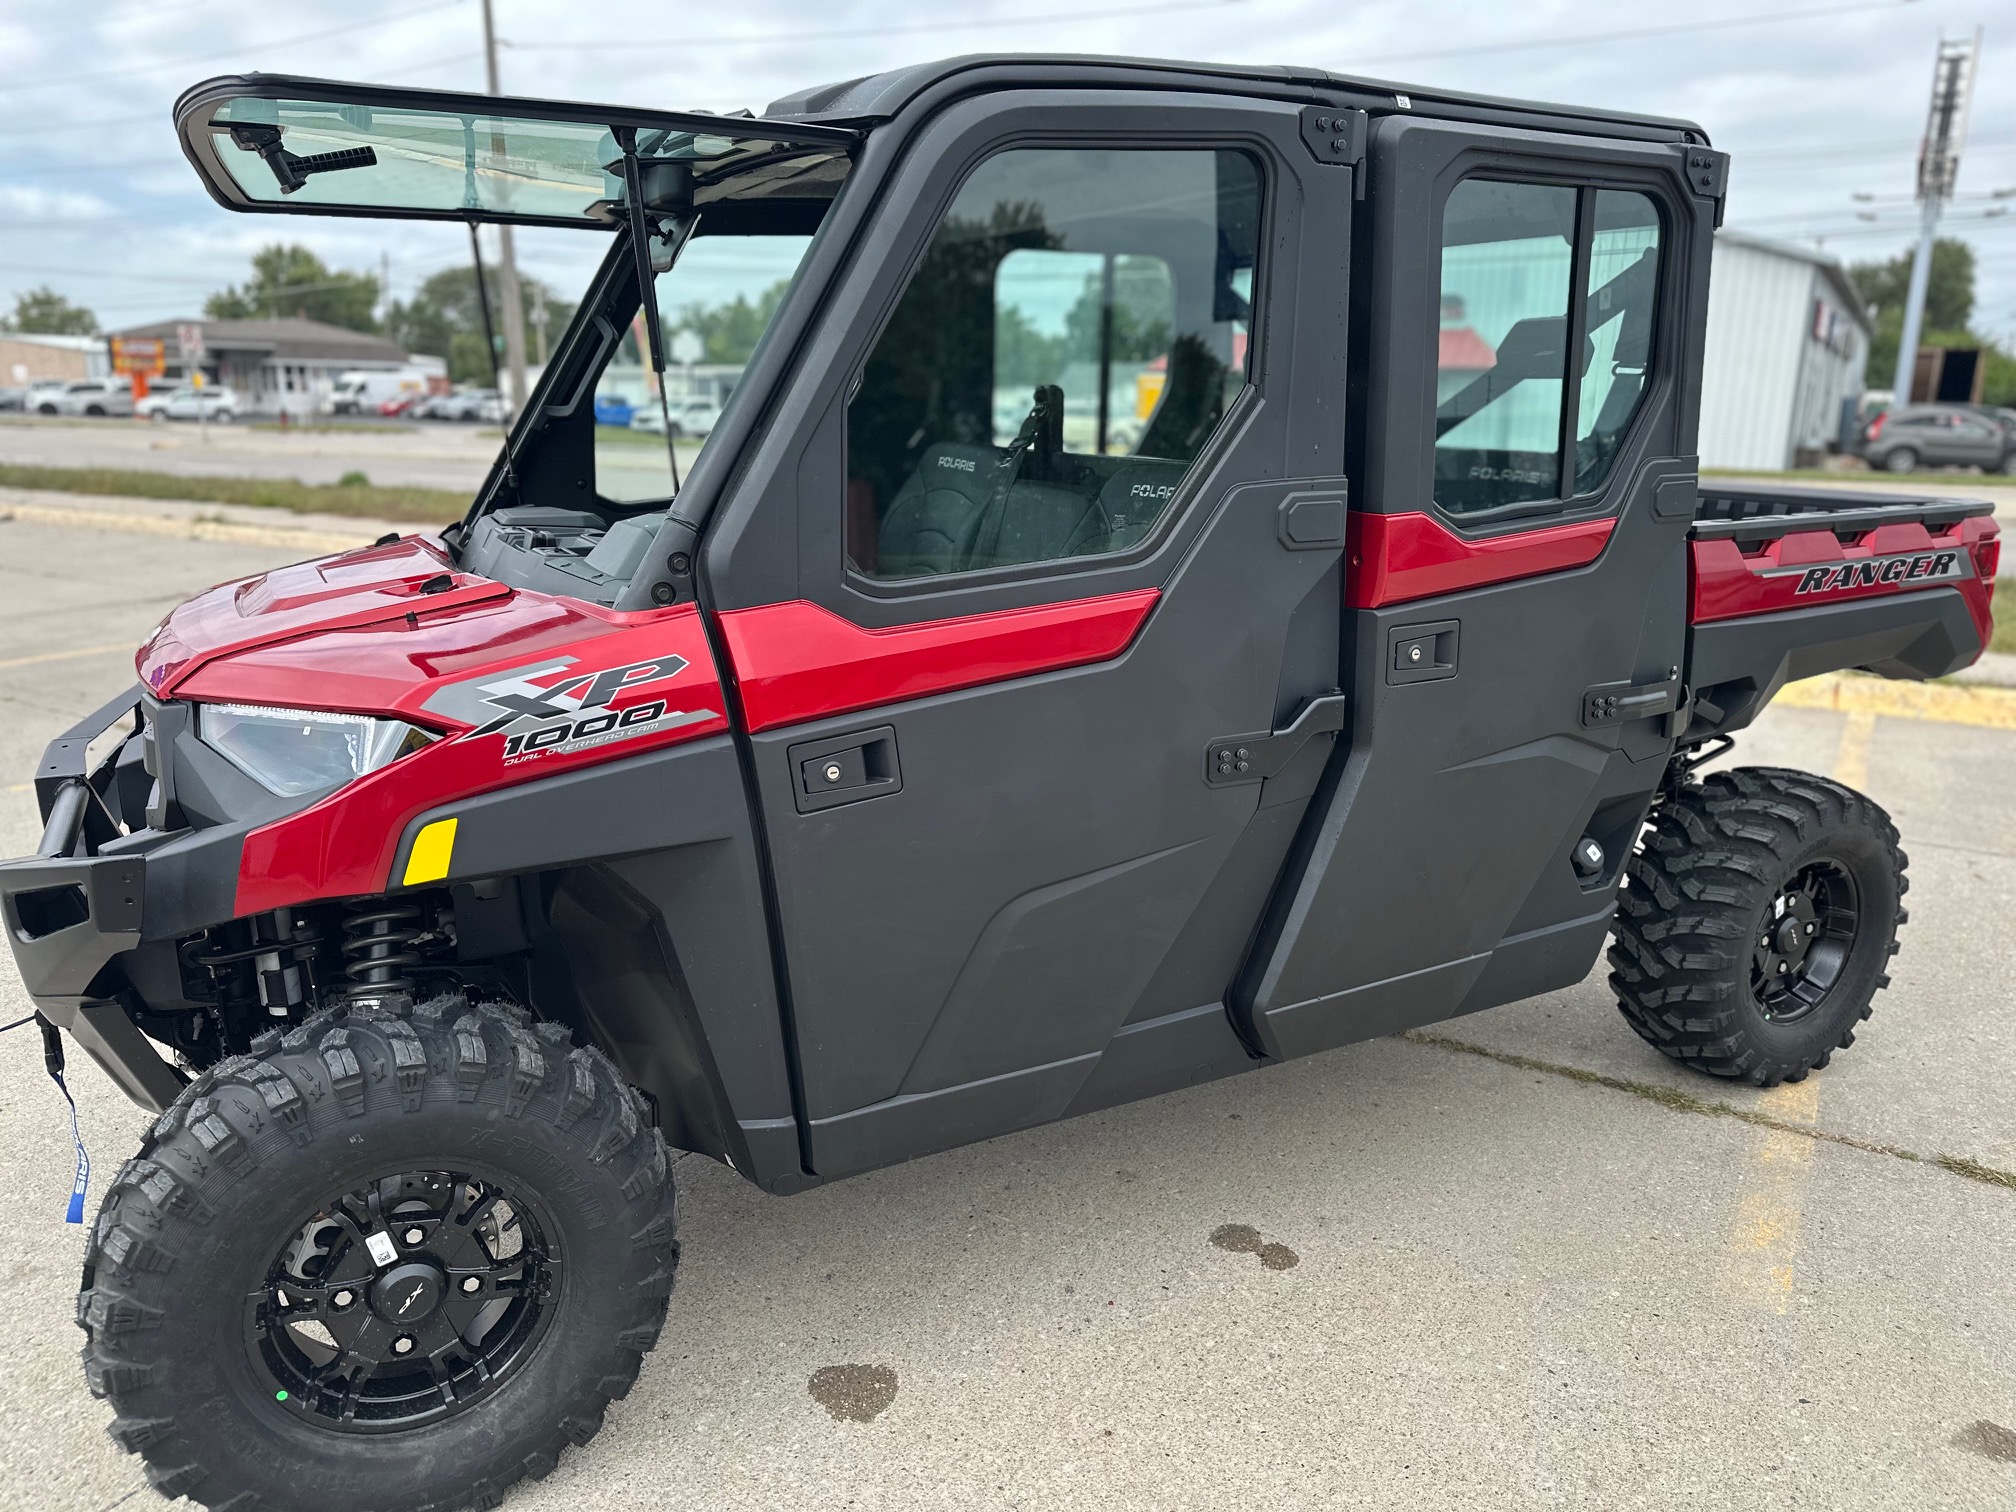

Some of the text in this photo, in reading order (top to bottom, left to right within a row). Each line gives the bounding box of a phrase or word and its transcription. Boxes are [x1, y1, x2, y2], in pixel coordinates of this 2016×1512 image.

[938, 456, 976, 472] POLARIS
[1468, 466, 1541, 485] POLARIS
[1130, 484, 1176, 499] POLAR
[1795, 552, 1957, 594] RANGER
[456, 654, 690, 742] XP
[503, 700, 667, 759] 1000
[504, 722, 659, 767] DUAL OVERHEAD CAM
[398, 1282, 424, 1315] XP
